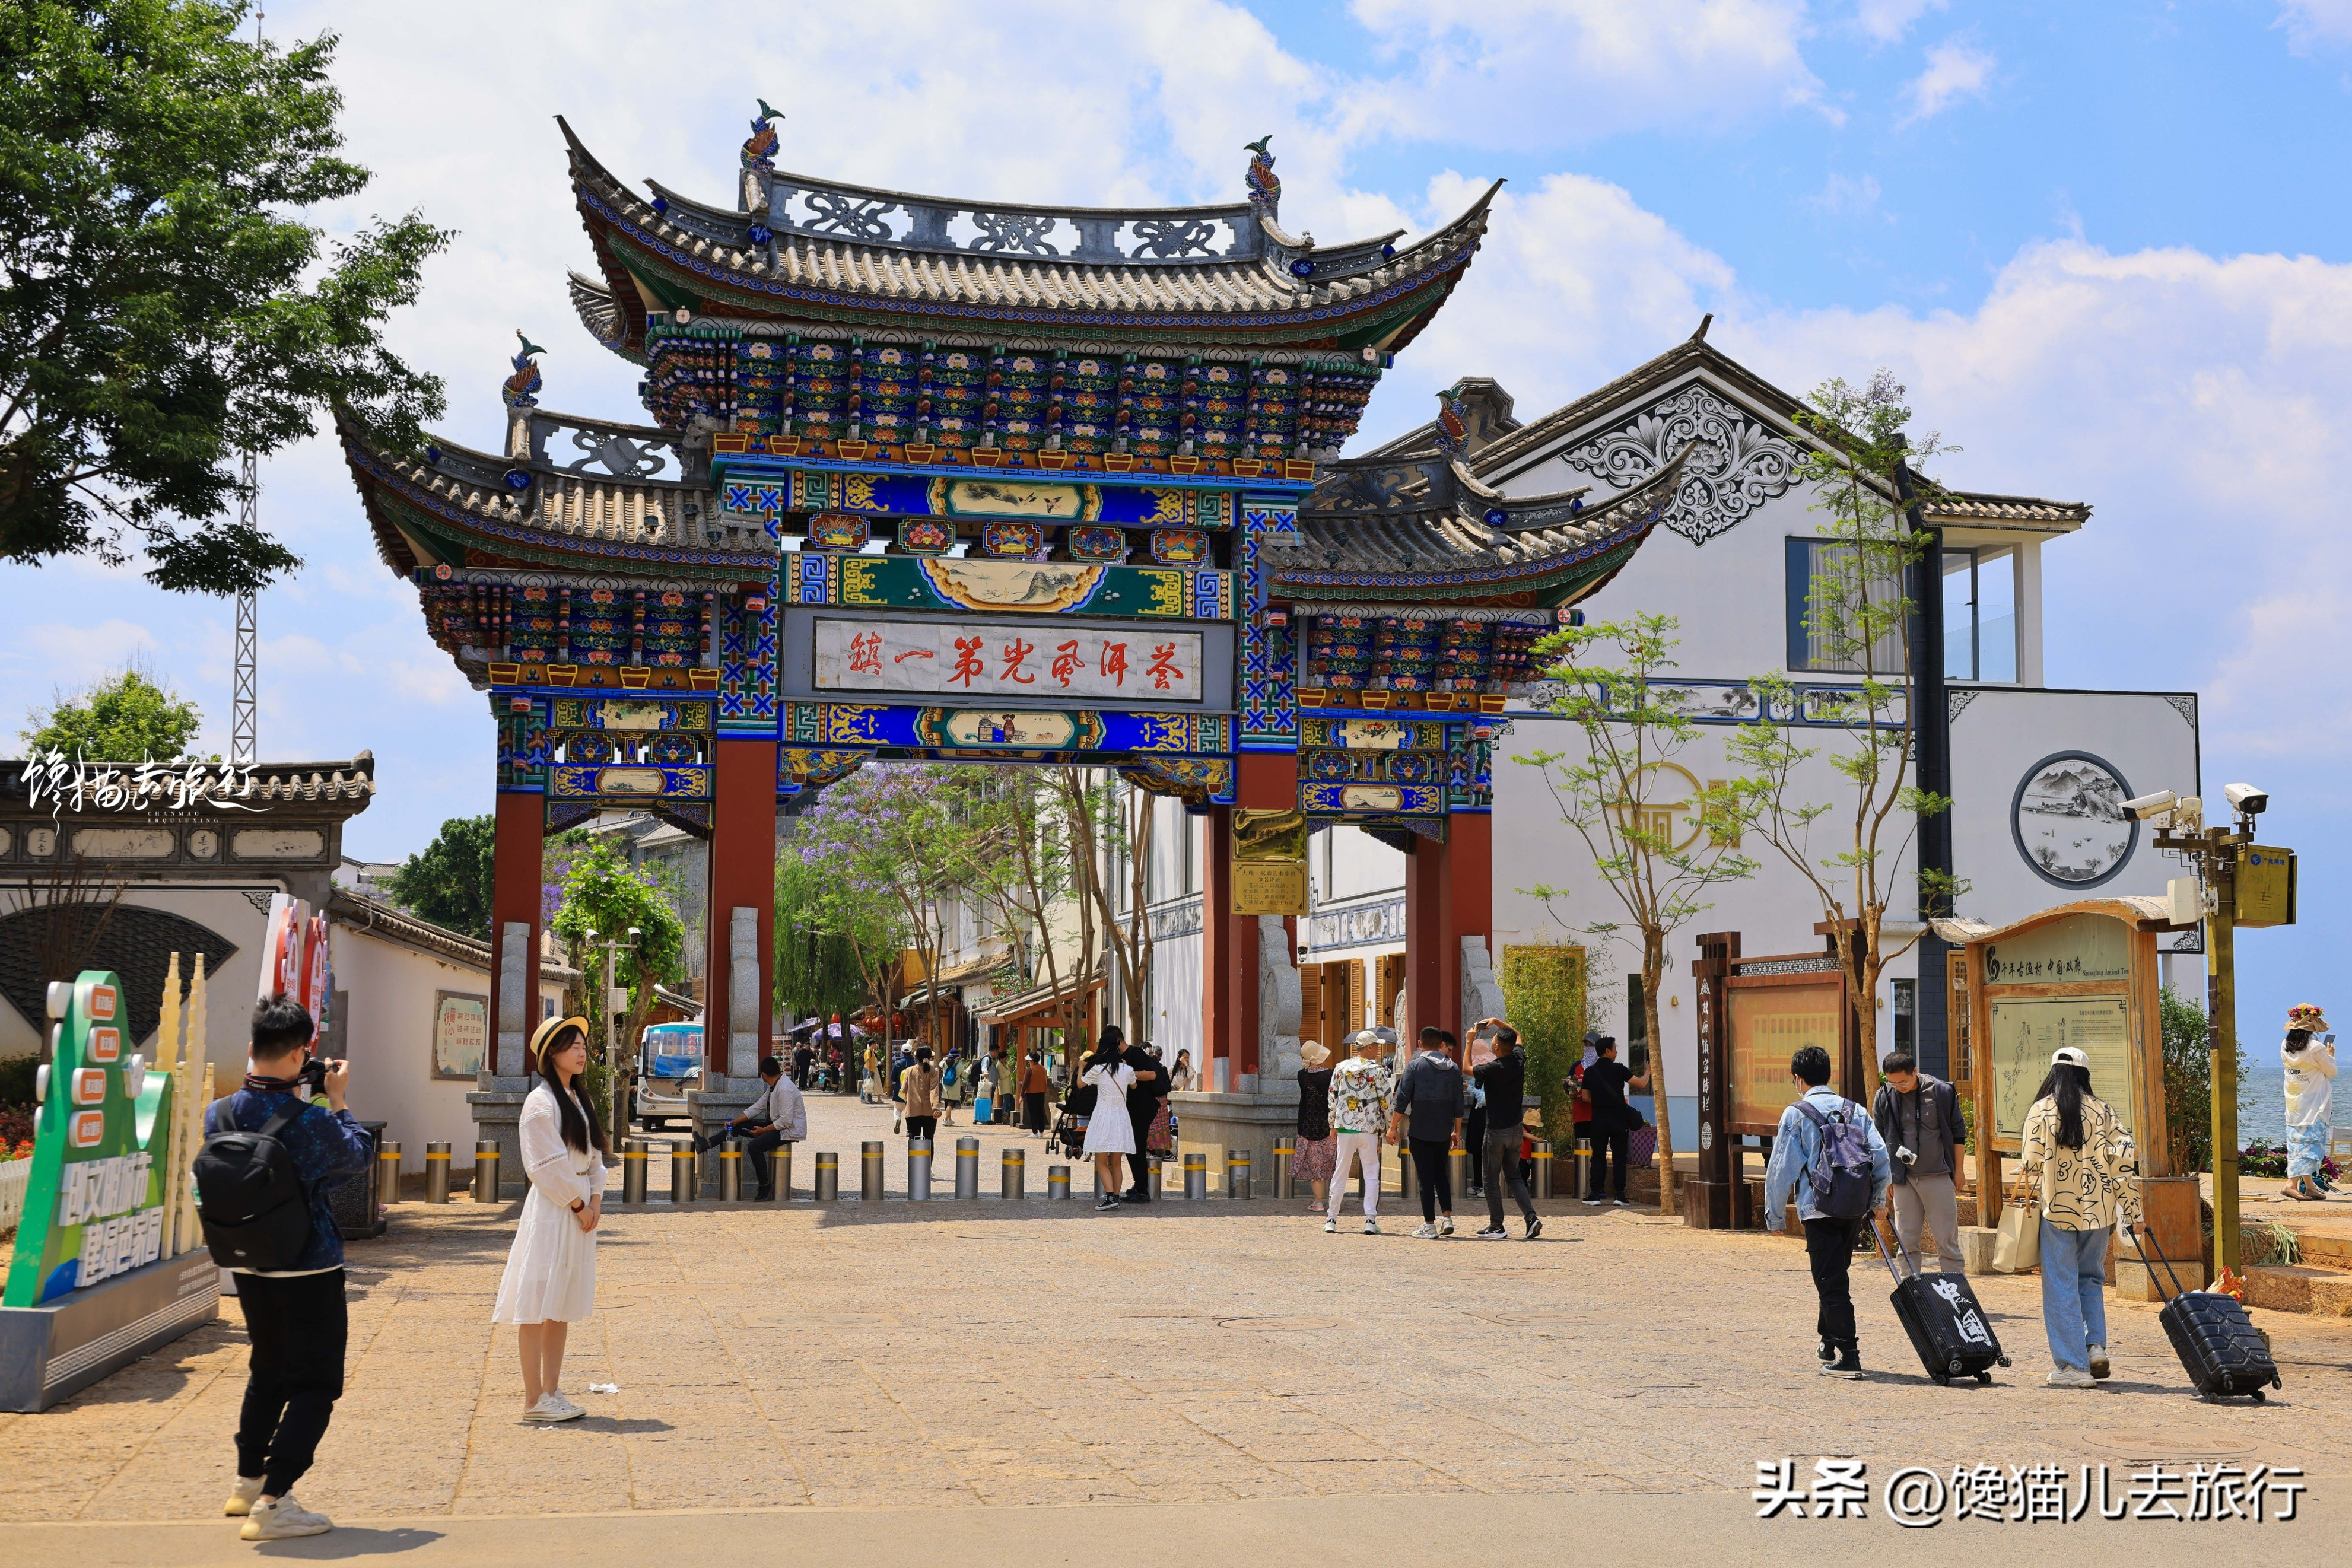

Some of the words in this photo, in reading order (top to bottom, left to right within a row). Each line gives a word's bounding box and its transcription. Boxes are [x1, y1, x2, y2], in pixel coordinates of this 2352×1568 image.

[2001, 959, 2042, 979] 千年古渔村
[1701, 1000, 1709, 1112] 双廊镇宣传栏
